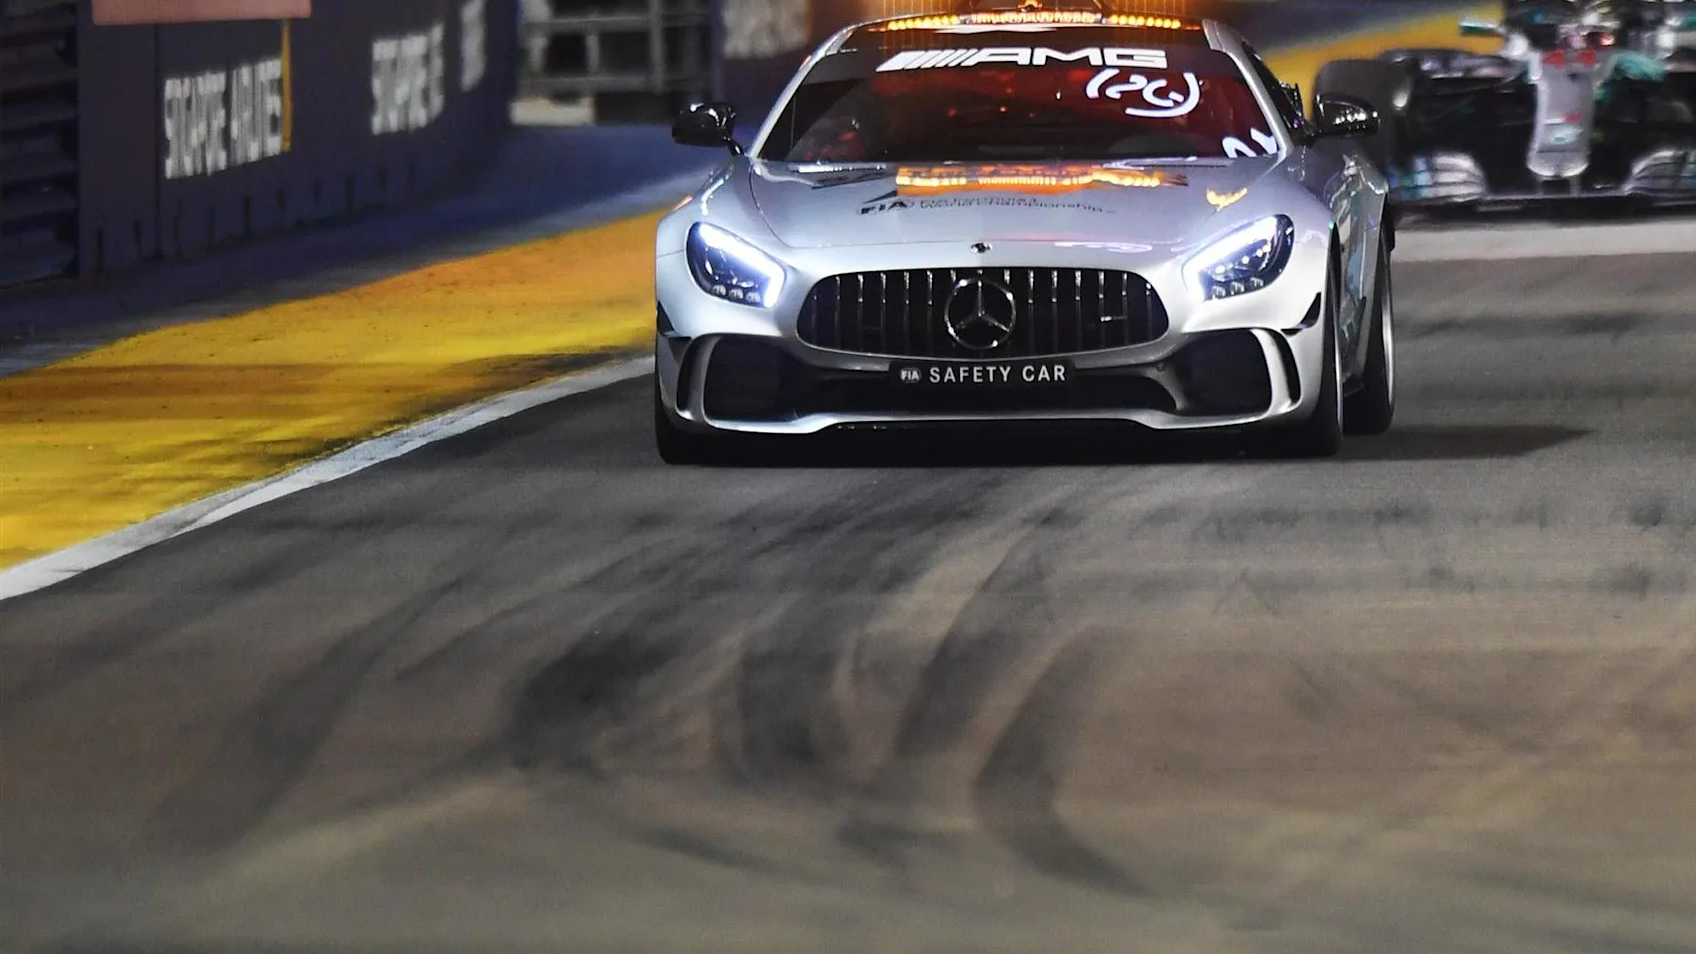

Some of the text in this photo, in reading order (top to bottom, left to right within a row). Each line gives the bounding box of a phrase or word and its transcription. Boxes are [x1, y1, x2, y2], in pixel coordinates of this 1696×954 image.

[900, 364, 1066, 383] FIA SAFETY CAR
